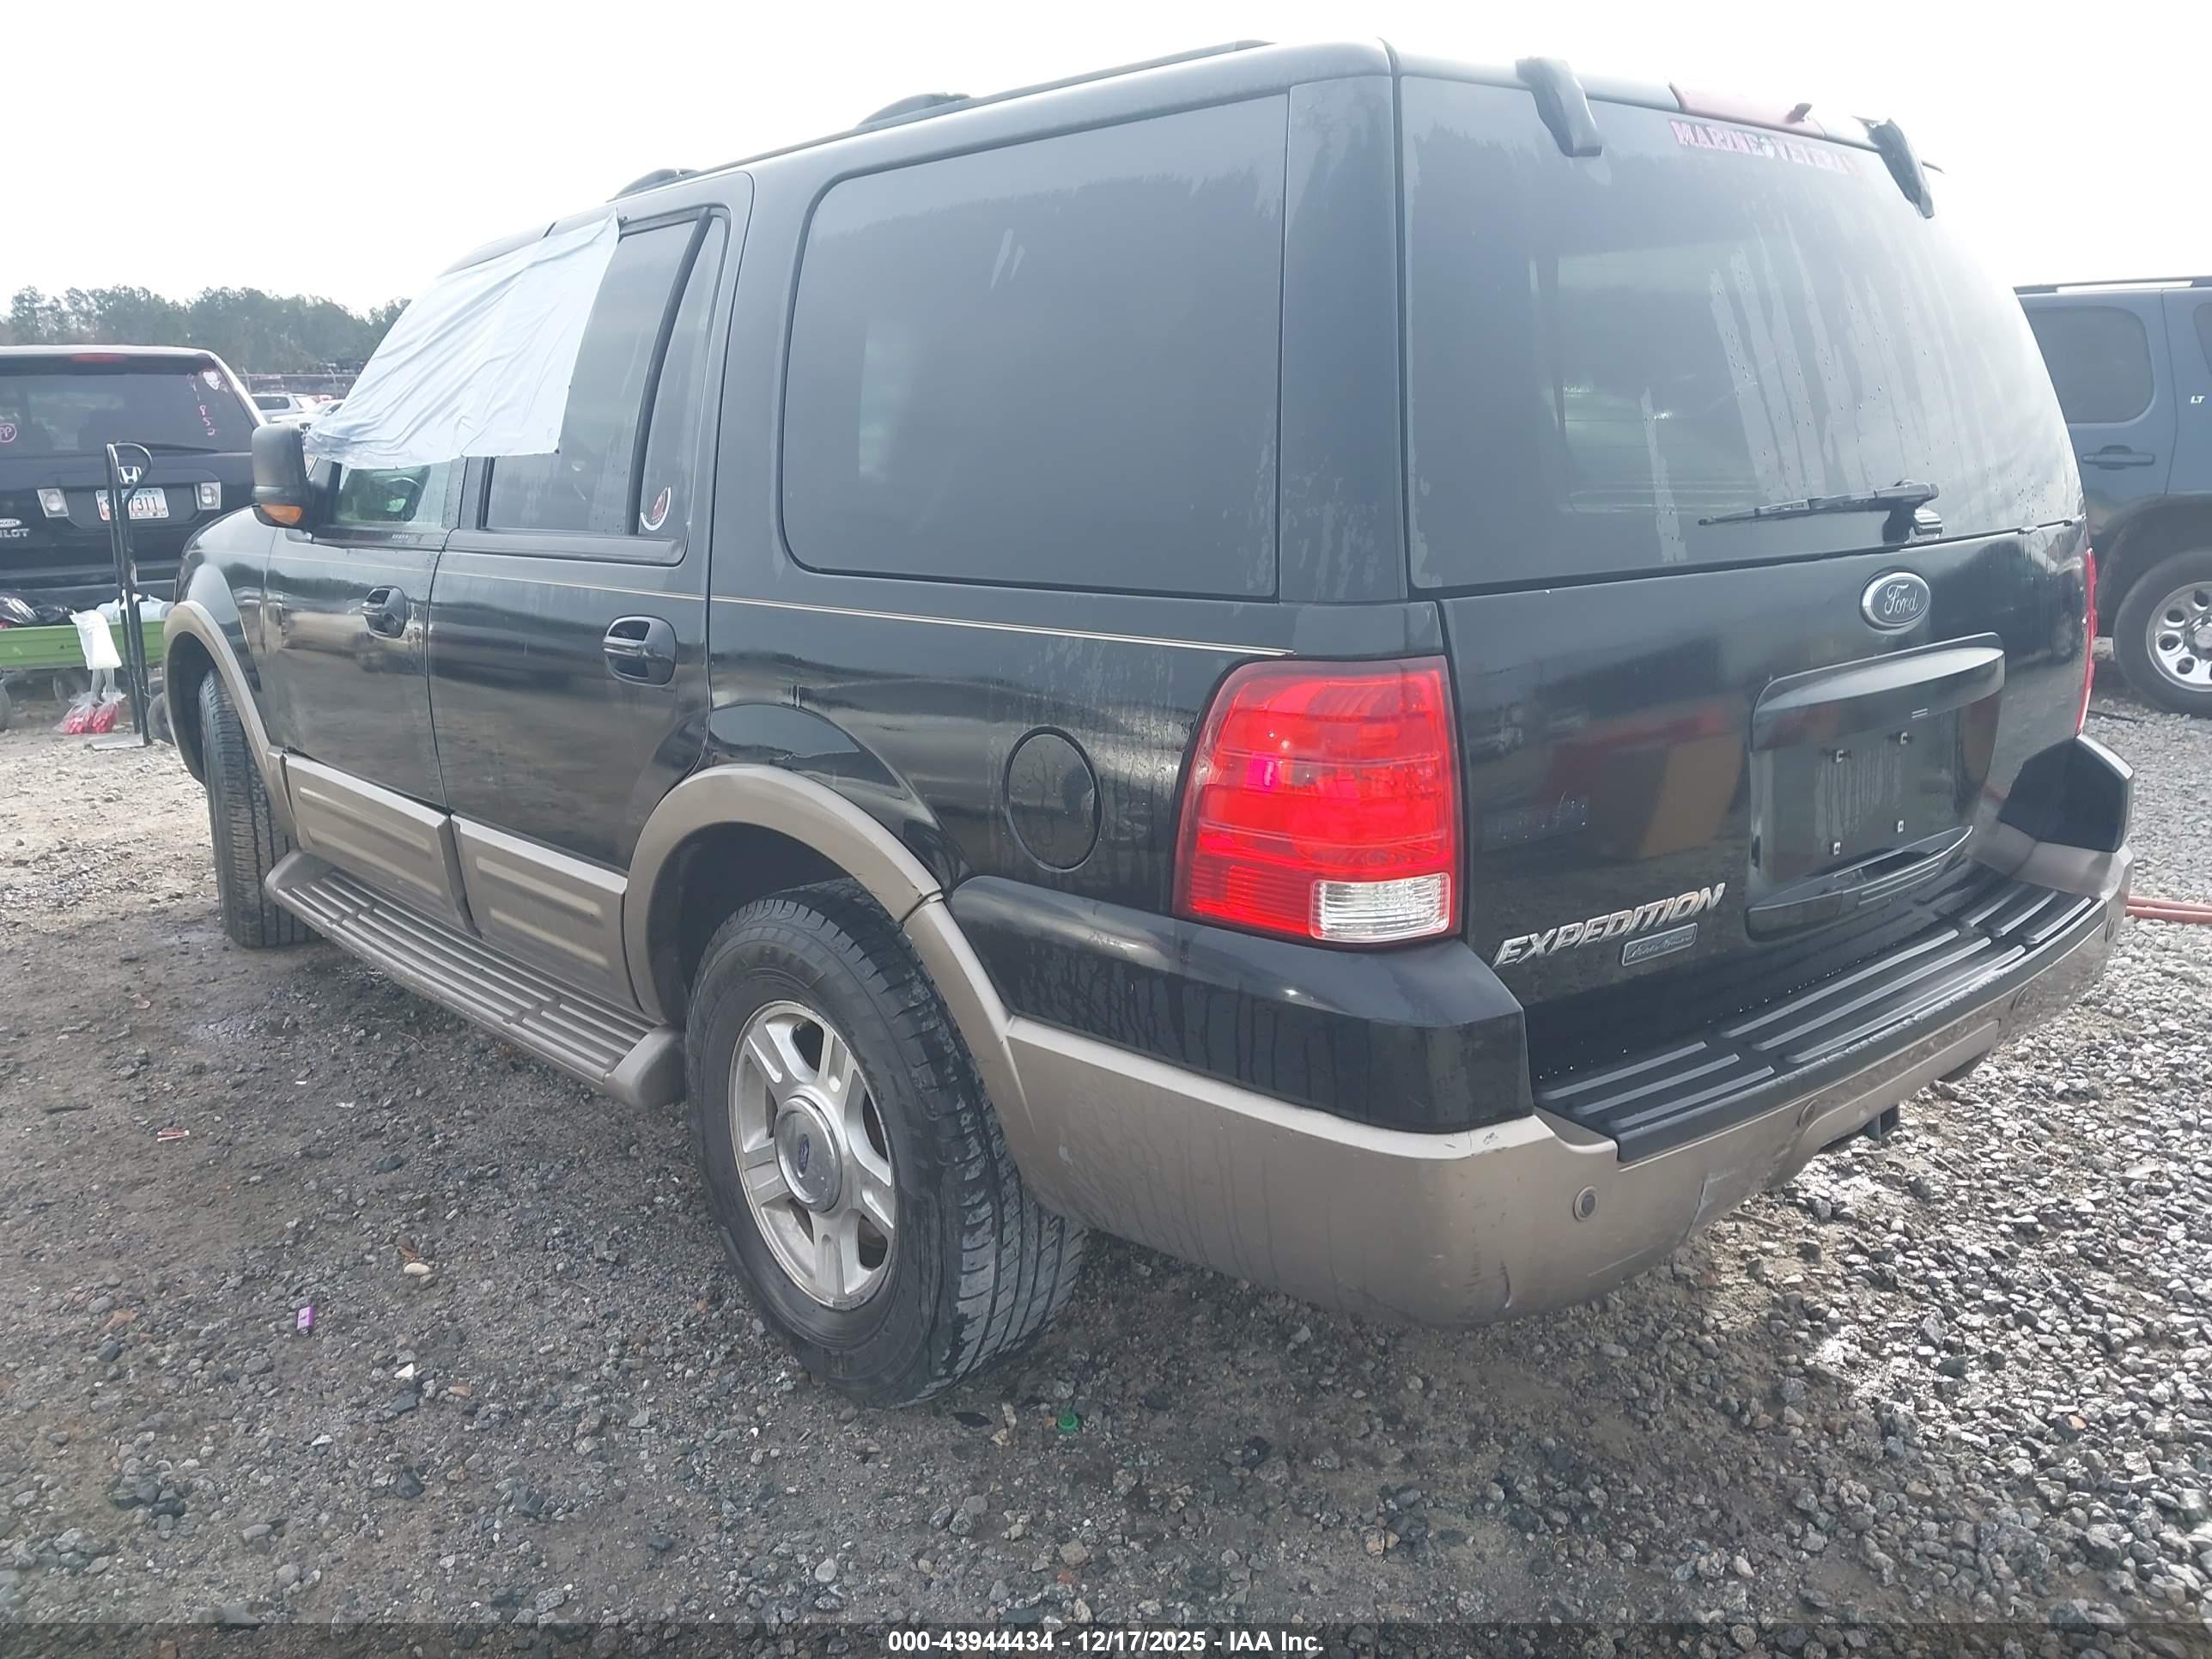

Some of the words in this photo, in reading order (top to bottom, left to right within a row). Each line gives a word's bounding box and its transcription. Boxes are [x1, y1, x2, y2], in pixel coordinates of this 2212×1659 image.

[2191, 395, 2206, 404] LT
[0, 527, 30, 538] ILOT
[1884, 583, 1918, 616] Ford
[1492, 882, 1726, 970] EXPEDITION
